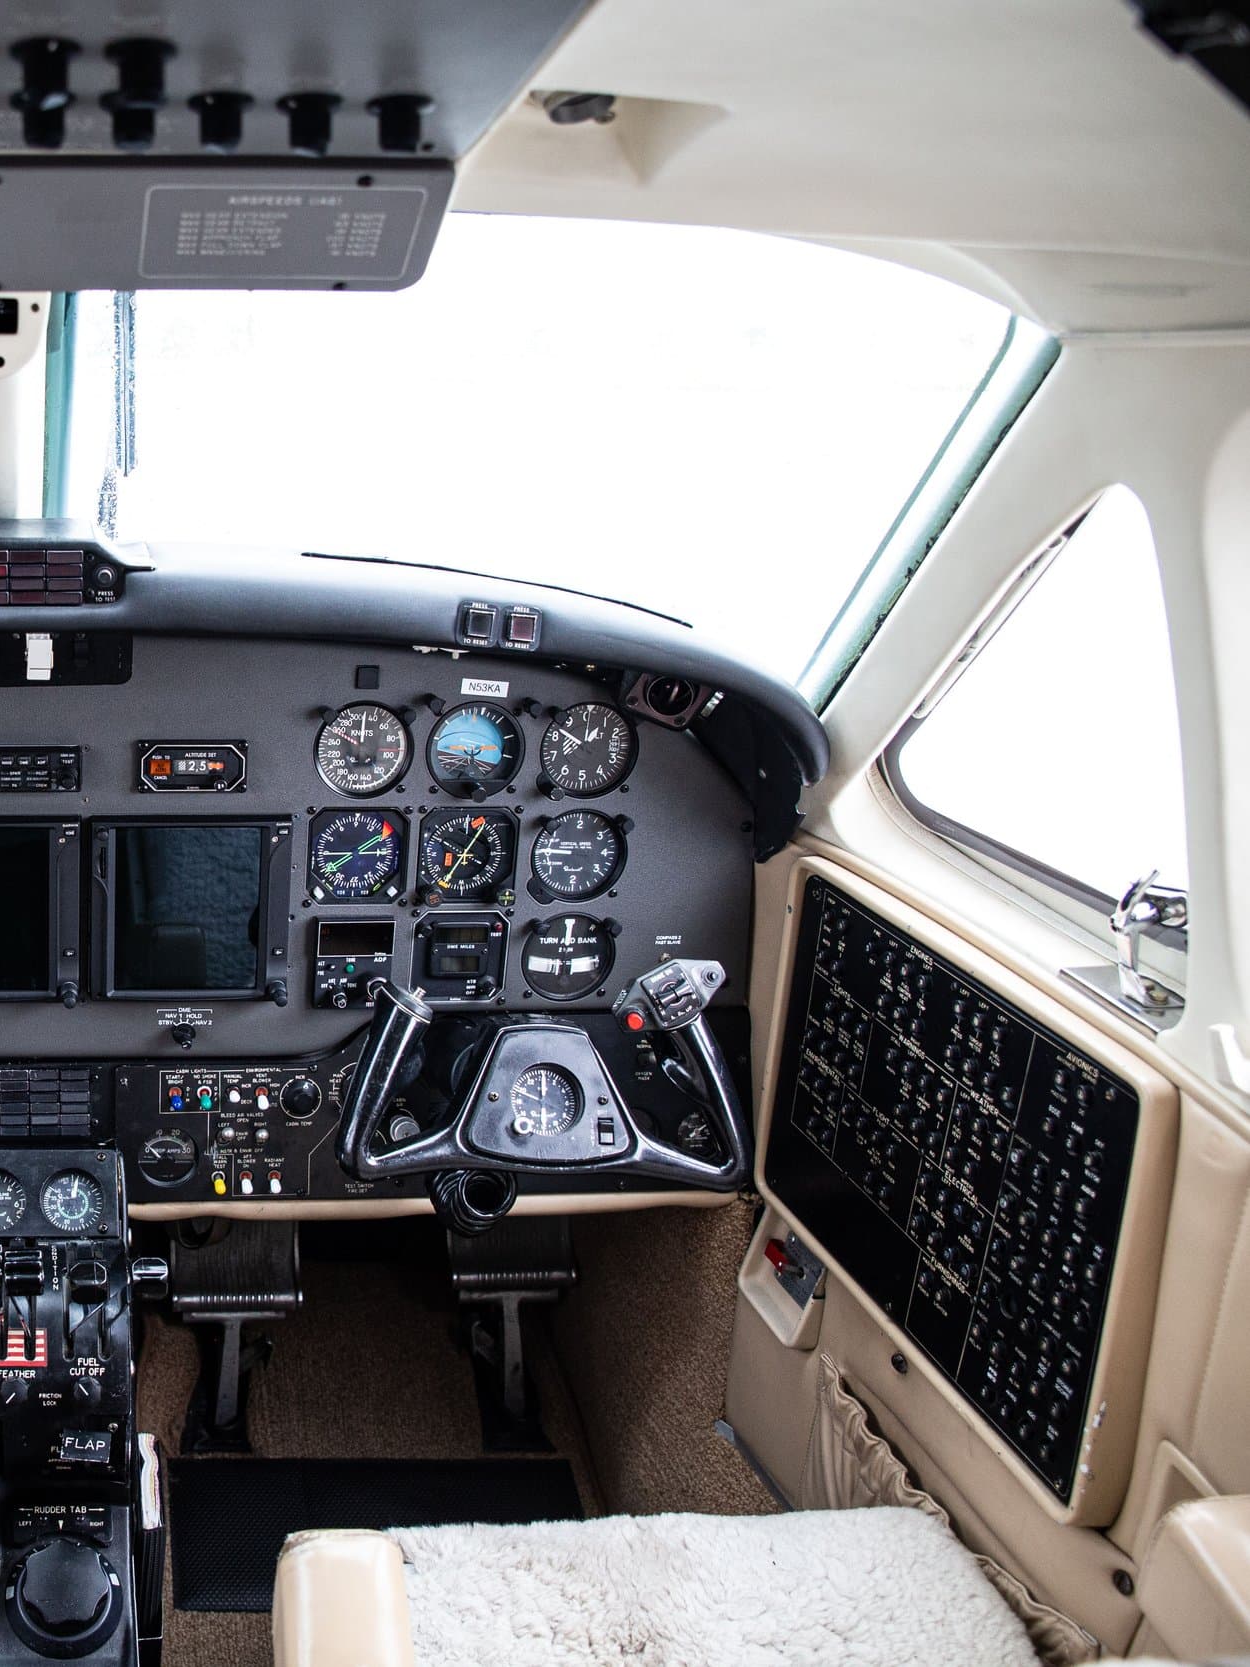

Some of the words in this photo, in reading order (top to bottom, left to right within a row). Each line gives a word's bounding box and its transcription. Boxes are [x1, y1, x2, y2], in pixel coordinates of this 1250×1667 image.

[468, 682, 501, 693] N53KA
[565, 716, 573, 728] 9
[604, 716, 607, 728] 1
[551, 730, 559, 742] 8
[611, 727, 619, 738] 2
[550, 750, 558, 761] 7
[608, 753, 617, 764] 3
[561, 765, 569, 775] 6
[578, 770, 586, 780] 5
[596, 764, 603, 775] 4
[576, 820, 583, 829] 2
[596, 831, 604, 840] 3
[601, 848, 608, 857] 4
[593, 864, 600, 873] 3
[569, 875, 576, 884] 2
[539, 937, 558, 945] TURN
[560, 937, 575, 945] AD
[910, 945, 934, 966] ENGINES
[1066, 1051, 1099, 1077] AVIONICS
[970, 1089, 999, 1117] WEATHER
[872, 1107, 890, 1125] FLIGHT
[944, 1170, 979, 1204] ELECTRICAL
[77, 1357, 99, 1366] FUEL
[69, 1368, 85, 1376] CUT
[88, 1368, 106, 1377] OFF
[64, 1437, 106, 1451] FLAP
[34, 1506, 67, 1514] RUDDER
